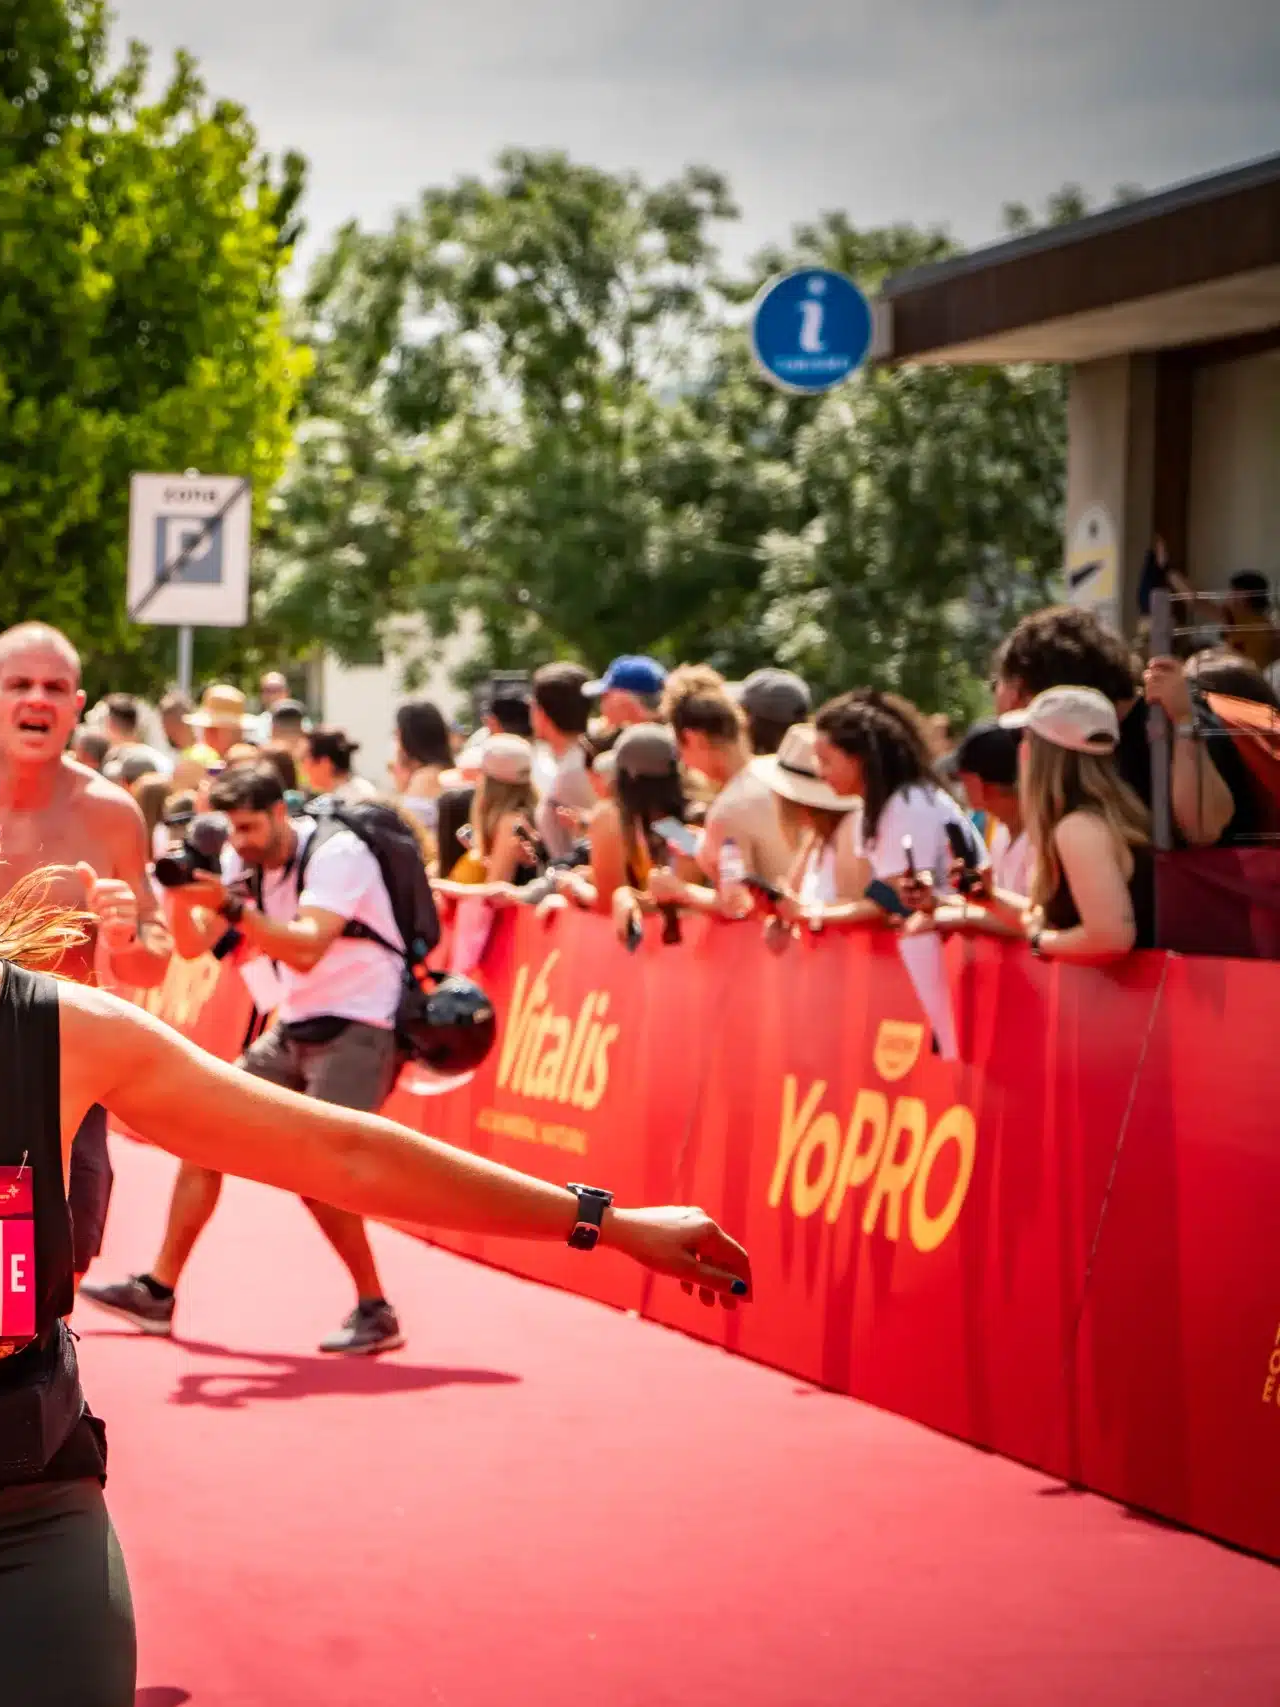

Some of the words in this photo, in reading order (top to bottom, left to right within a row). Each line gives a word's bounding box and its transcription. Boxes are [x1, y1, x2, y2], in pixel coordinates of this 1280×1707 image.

[495, 948, 620, 1111] Vitalis
[767, 1073, 977, 1252] YoPRO
[9, 1253, 27, 1293] E
